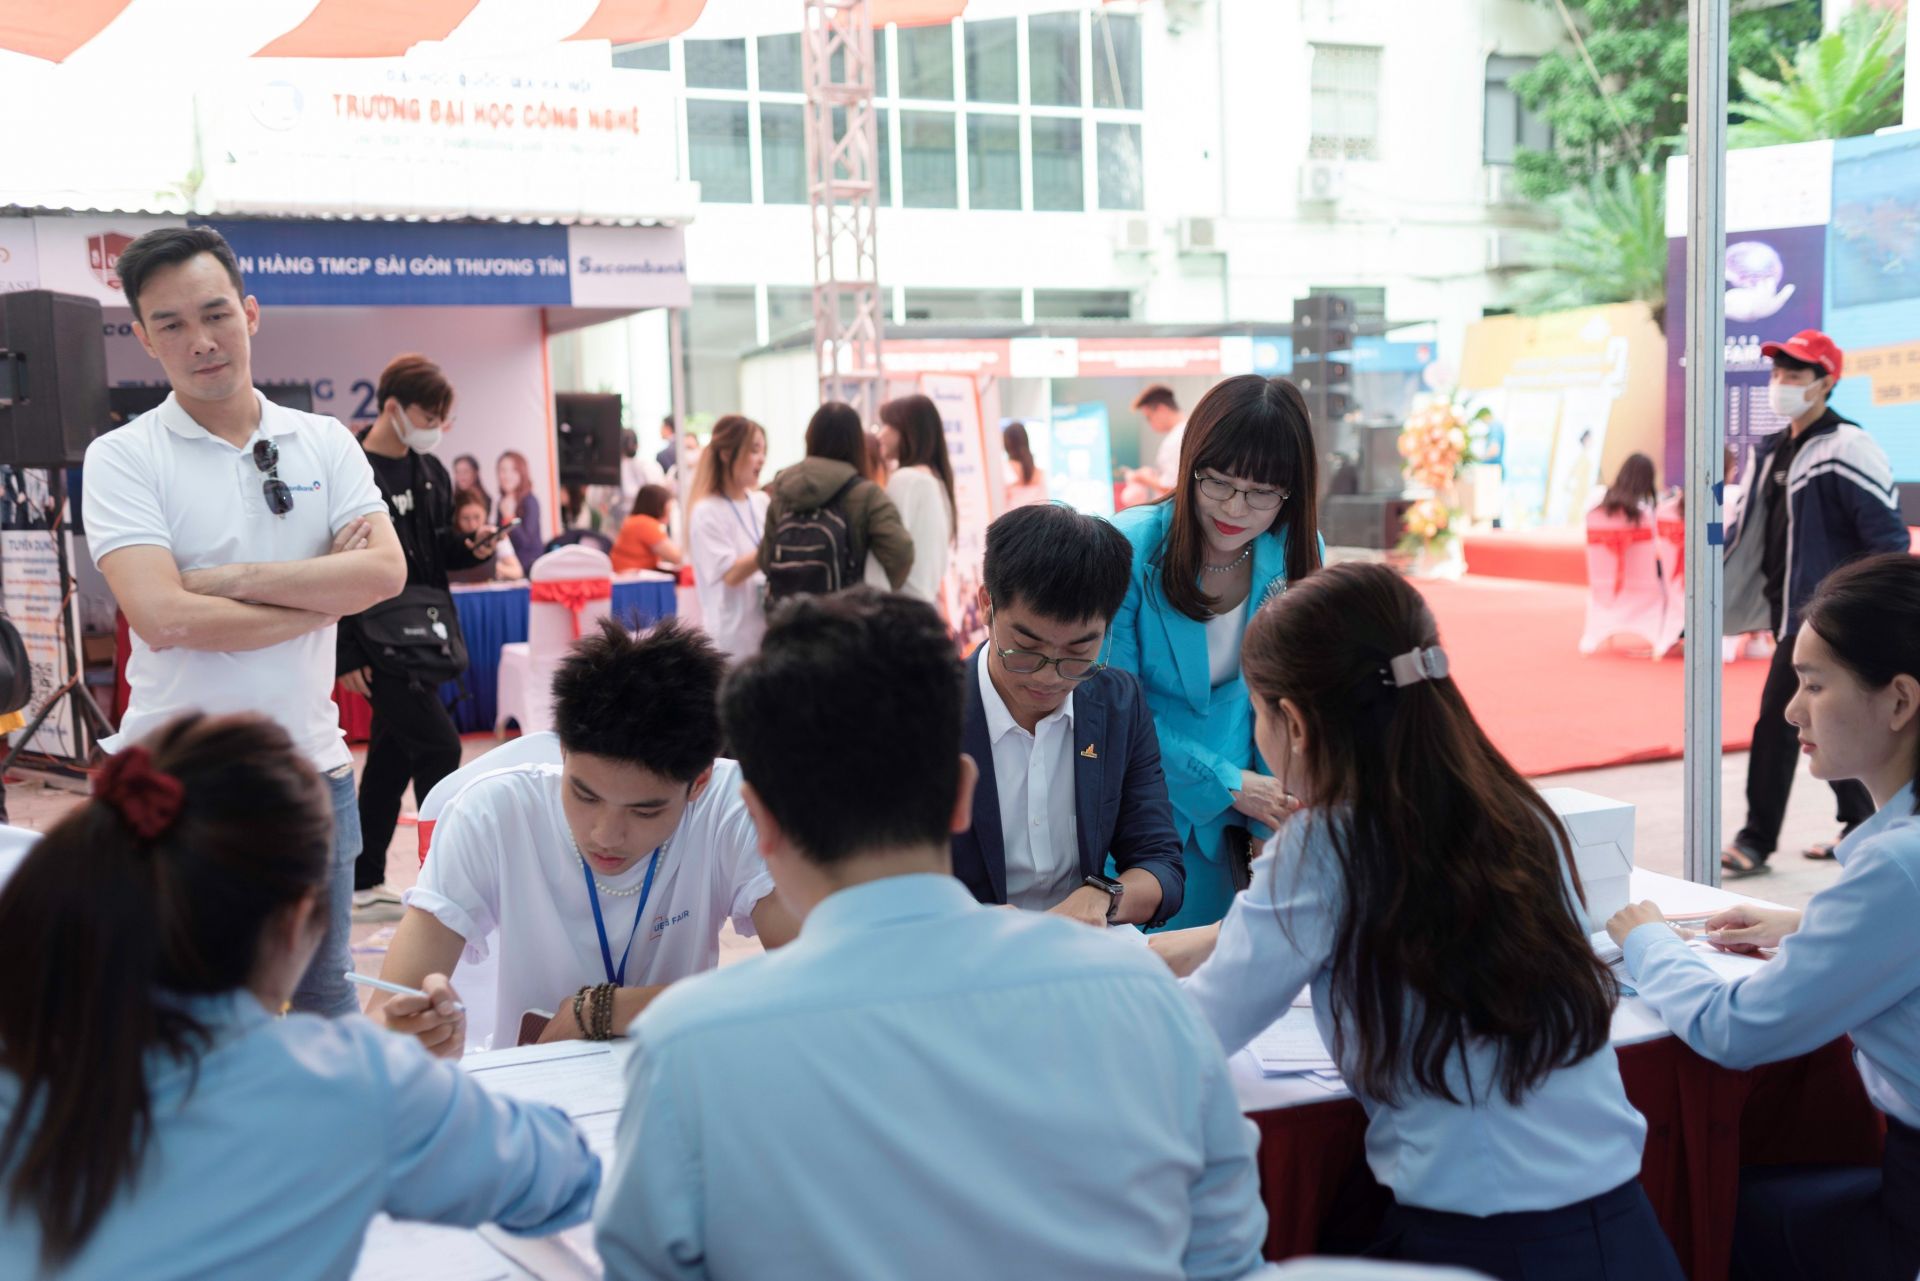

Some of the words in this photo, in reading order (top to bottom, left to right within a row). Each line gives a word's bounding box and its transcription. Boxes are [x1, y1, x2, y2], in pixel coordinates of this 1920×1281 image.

[333, 93, 420, 122] TRƯỜNG
[430, 99, 465, 126] ĐẠI
[474, 103, 514, 130] HỌC
[523, 101, 579, 131] CÔNG
[588, 106, 640, 135] NGHỆ
[258, 253, 314, 275] HÀNG
[318, 256, 372, 275] TMCP
[375, 254, 407, 275] SÀI
[410, 254, 452, 276] GÒN
[454, 256, 535, 276] THƯƠNG
[538, 255, 567, 276] TÍN
[578, 256, 687, 275] Sacombank
[671, 910, 690, 925] FAIR
